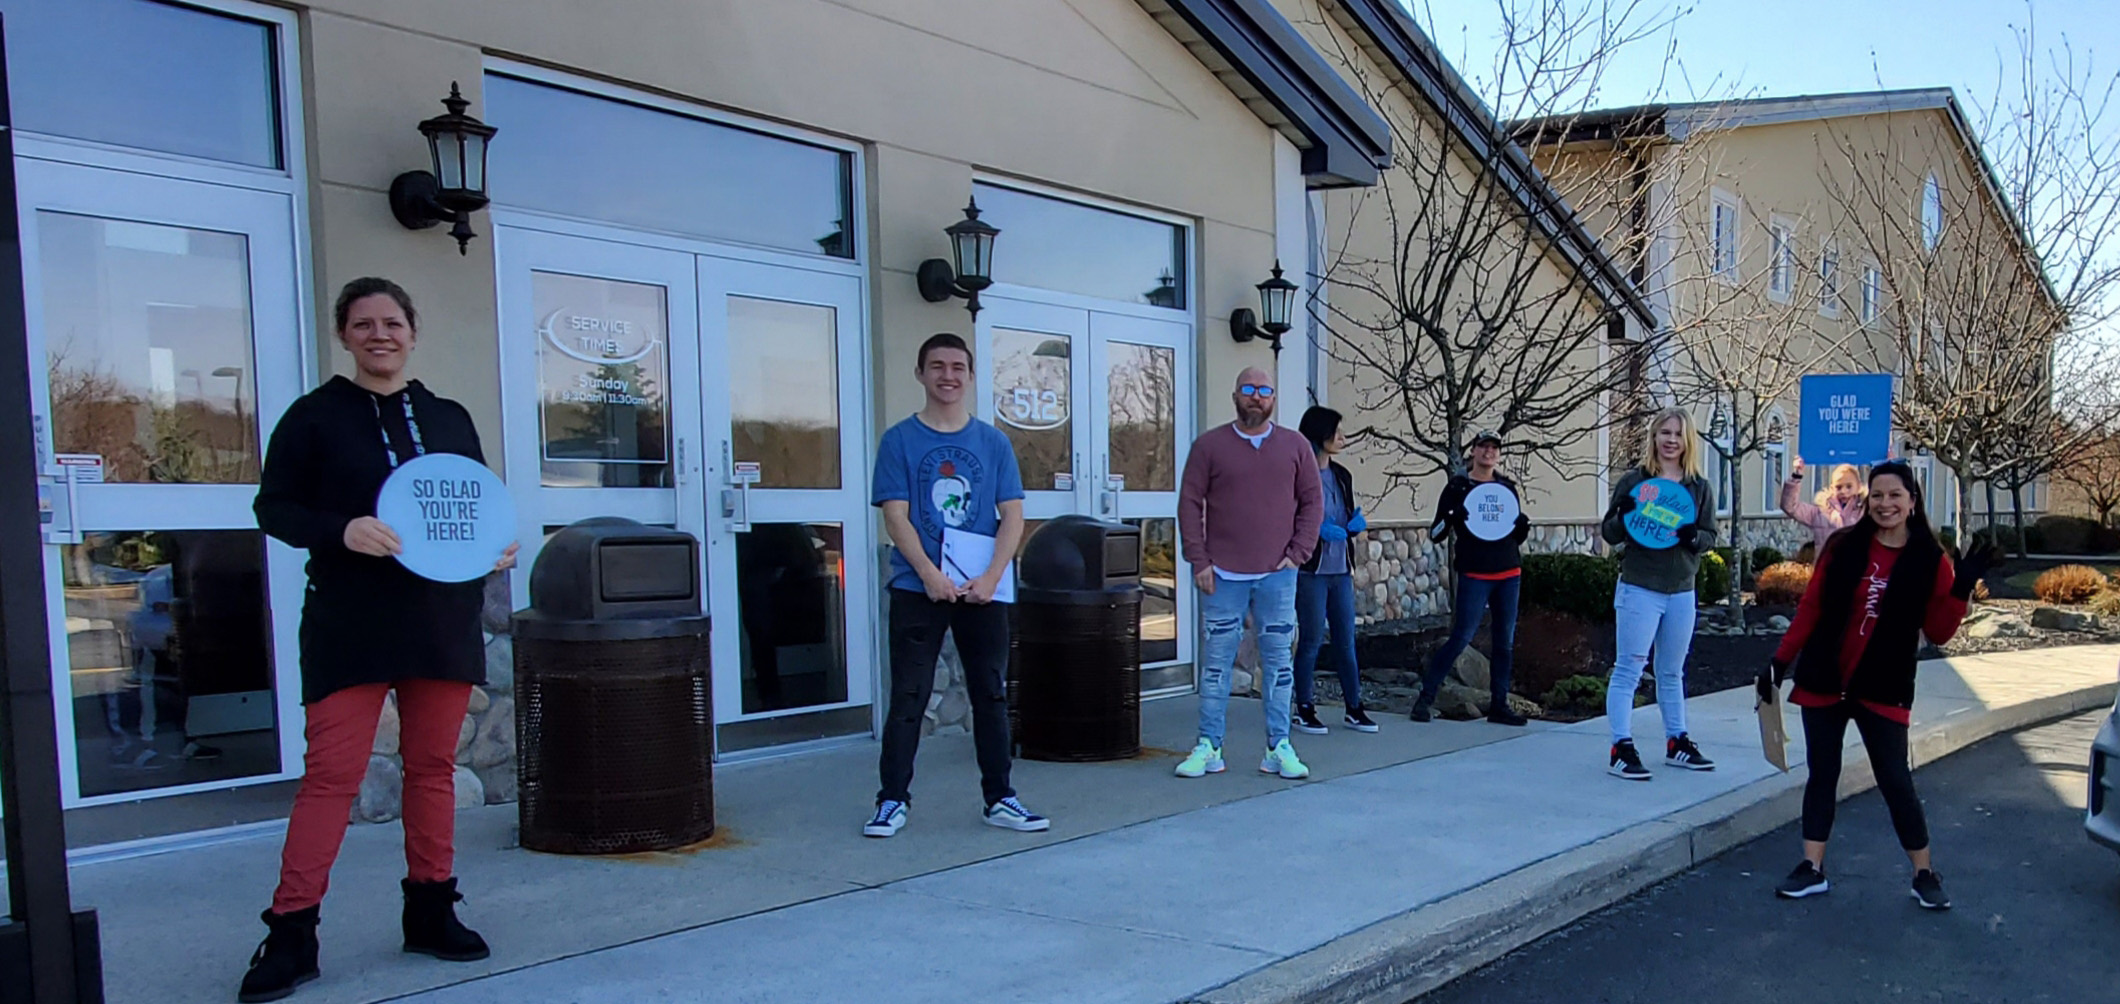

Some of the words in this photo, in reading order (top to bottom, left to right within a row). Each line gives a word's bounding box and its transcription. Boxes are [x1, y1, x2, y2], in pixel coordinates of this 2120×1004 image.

[571, 315, 632, 334] SERVICE
[581, 336, 624, 353] TIMES
[579, 377, 629, 393] Sunday
[1013, 387, 1058, 420] 512
[1830, 394, 1857, 408] GLAD
[1818, 408, 1839, 421] YOU
[1841, 408, 1871, 421] WERE
[1829, 420, 1859, 434] HERE!
[938, 449, 983, 484] STRAUSS
[413, 479, 434, 498] SO
[440, 480, 481, 499] GLAD
[1484, 494, 1499, 503] YOU
[419, 501, 479, 520] YOU'RE
[1478, 503, 1504, 513] BELONG
[1482, 512, 1500, 522] HERE
[427, 522, 475, 541] HERE!
